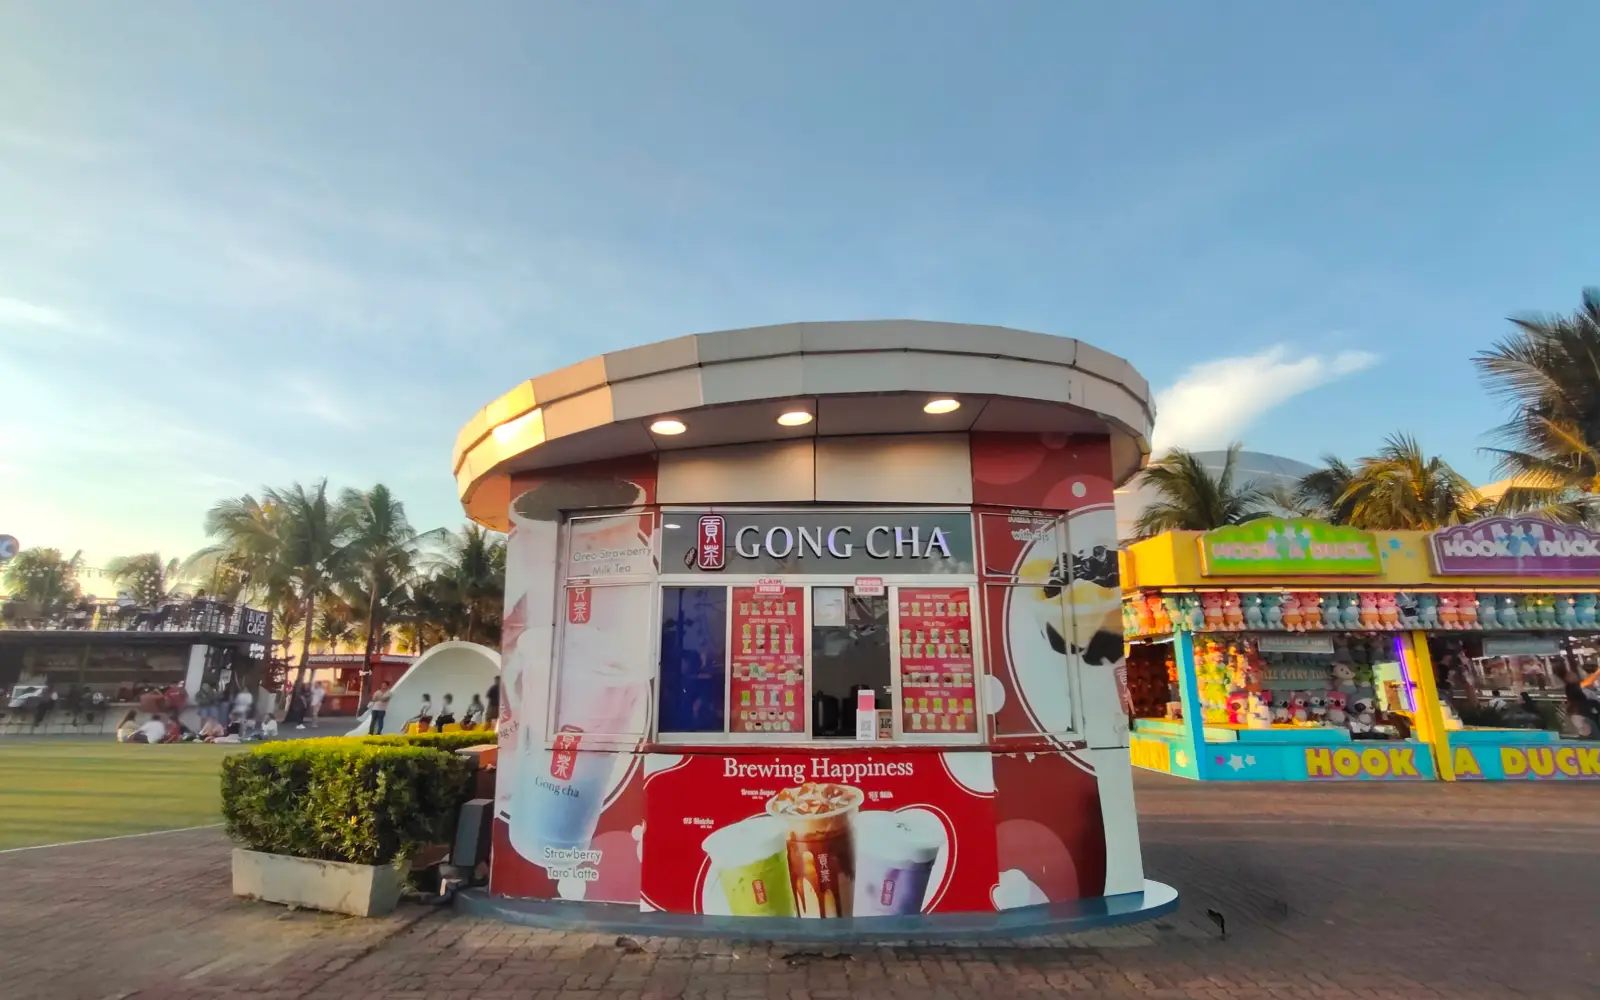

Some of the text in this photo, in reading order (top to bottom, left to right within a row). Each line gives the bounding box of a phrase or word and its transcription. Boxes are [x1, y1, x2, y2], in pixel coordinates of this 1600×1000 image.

[735, 525, 853, 559] GONG
[865, 526, 951, 559] CHA
[1011, 529, 1032, 540] with
[573, 547, 652, 561] Oreo Strawberry
[1212, 541, 1374, 560] HOOK A DUCK
[1443, 540, 1512, 557] HOOK
[1538, 539, 1600, 557] DUCK
[593, 563, 631, 575] Milk Tea
[246, 622, 266, 636] CAFE
[1305, 747, 1600, 776] HOOK A DUCK
[723, 757, 914, 783] Brewing Happiness
[535, 776, 580, 797] Gong cha
[545, 848, 601, 863] Strawberry
[547, 866, 597, 879] Taro Latte
